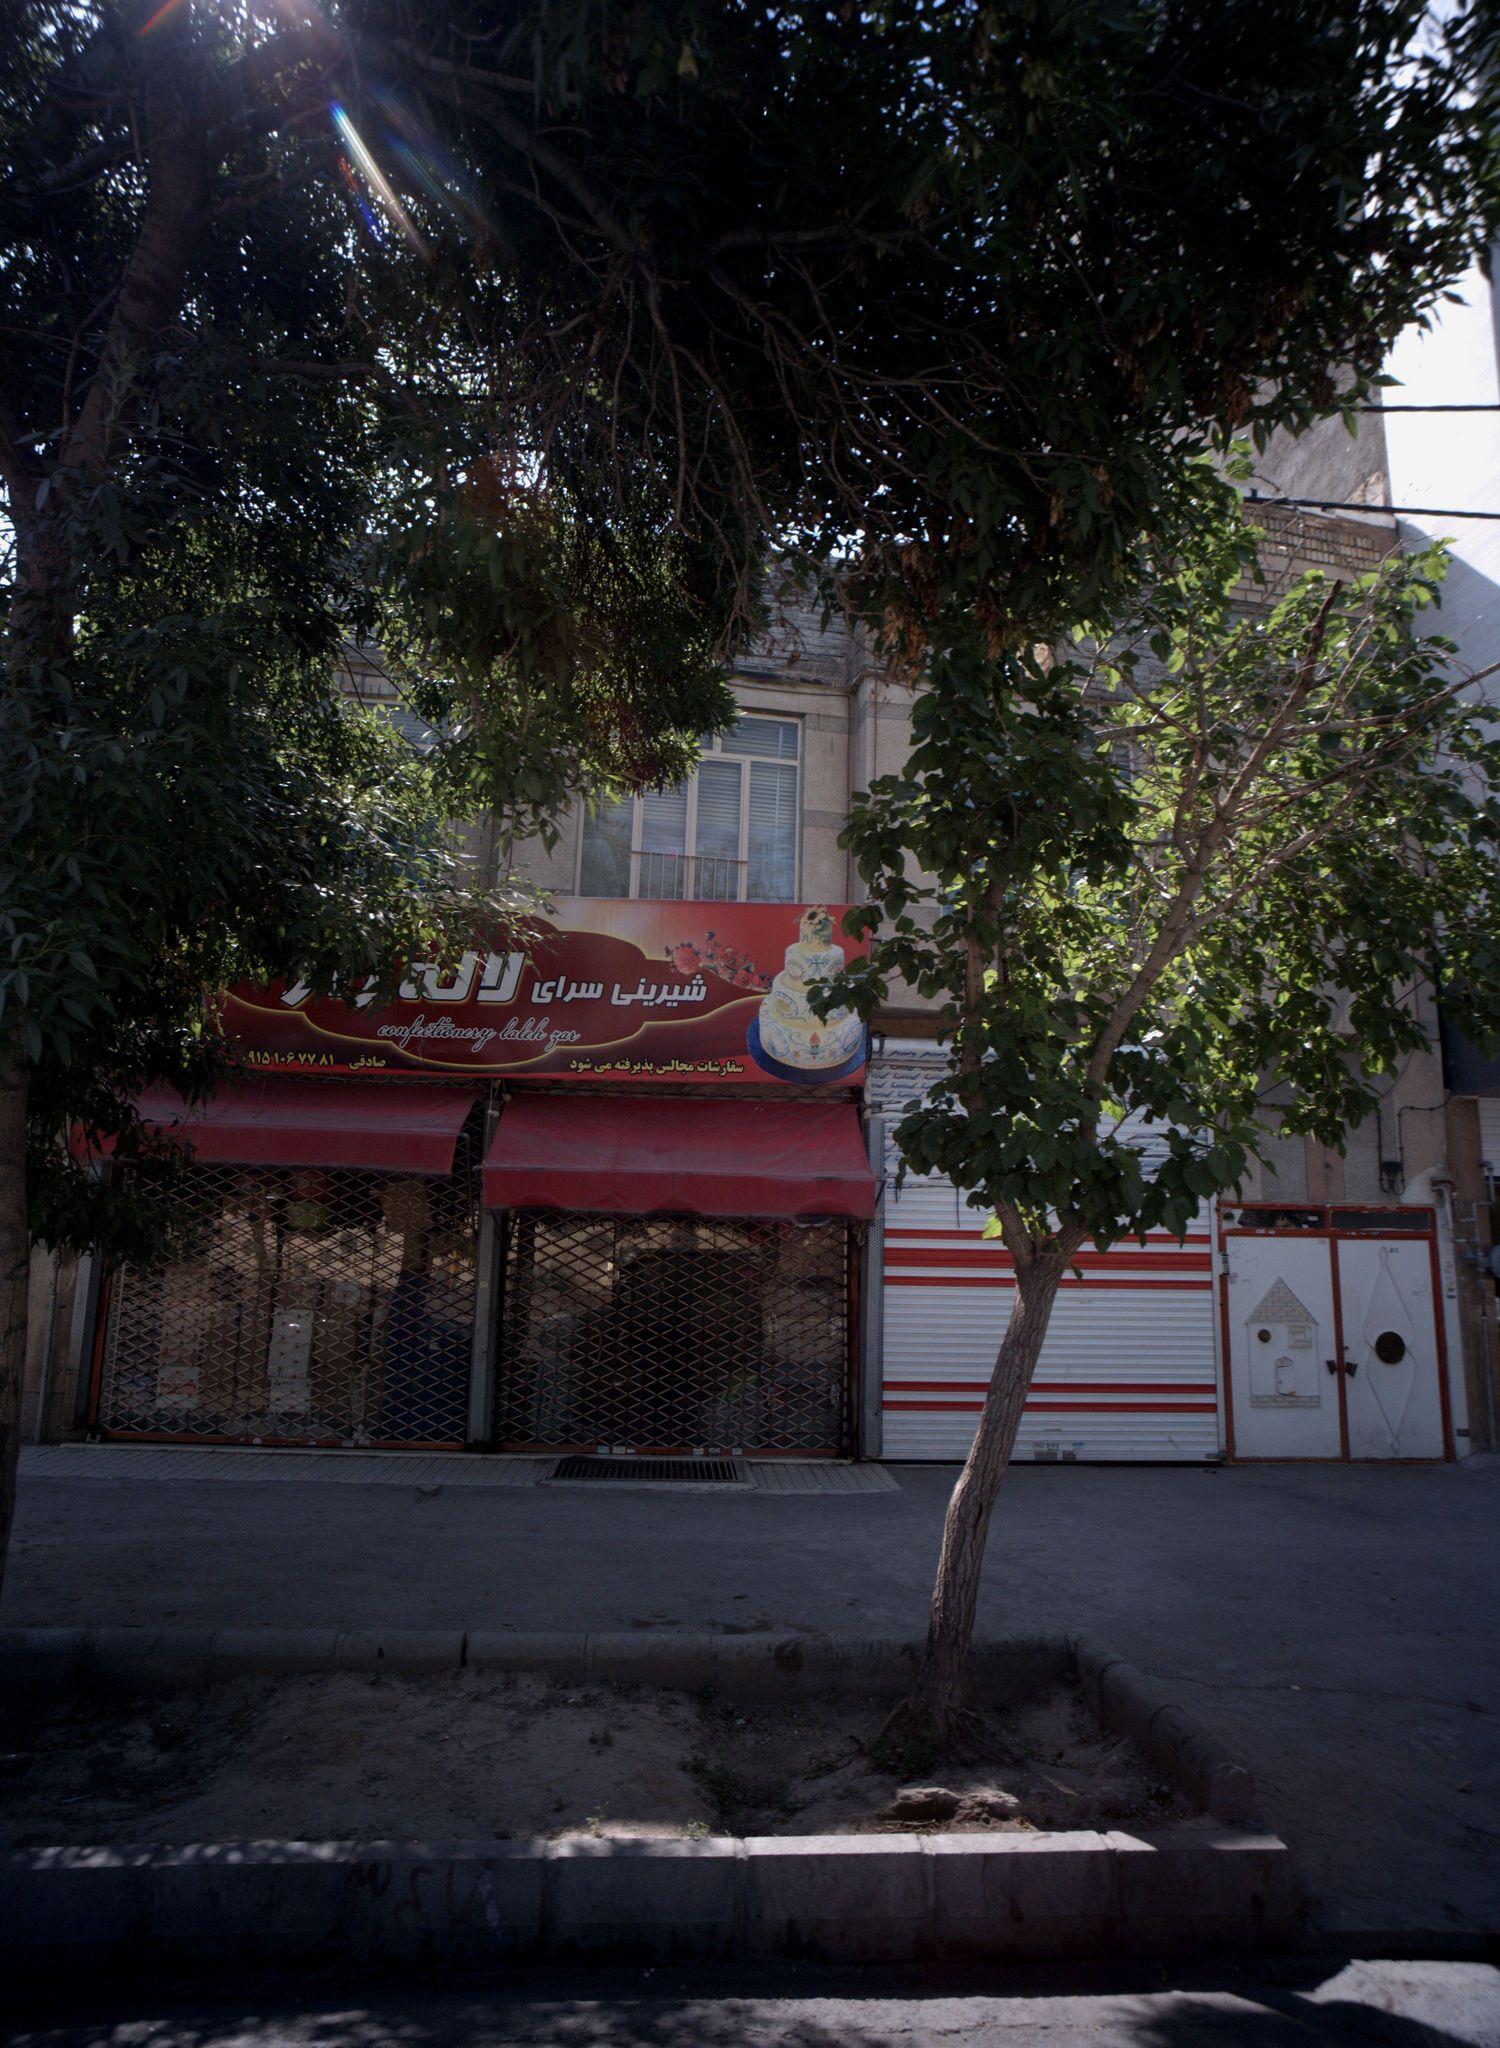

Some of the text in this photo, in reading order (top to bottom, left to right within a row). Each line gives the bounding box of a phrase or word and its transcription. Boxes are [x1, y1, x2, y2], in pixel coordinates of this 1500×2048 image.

[531, 975, 604, 1004] سرای
[610, 973, 707, 1008] شیرینی
[377, 1014, 581, 1053] confectionery laleh zar
[349, 1054, 386, 1069] صادقی
[569, 1058, 744, 1075] سفارشات مجالس پذیرفته می شود
